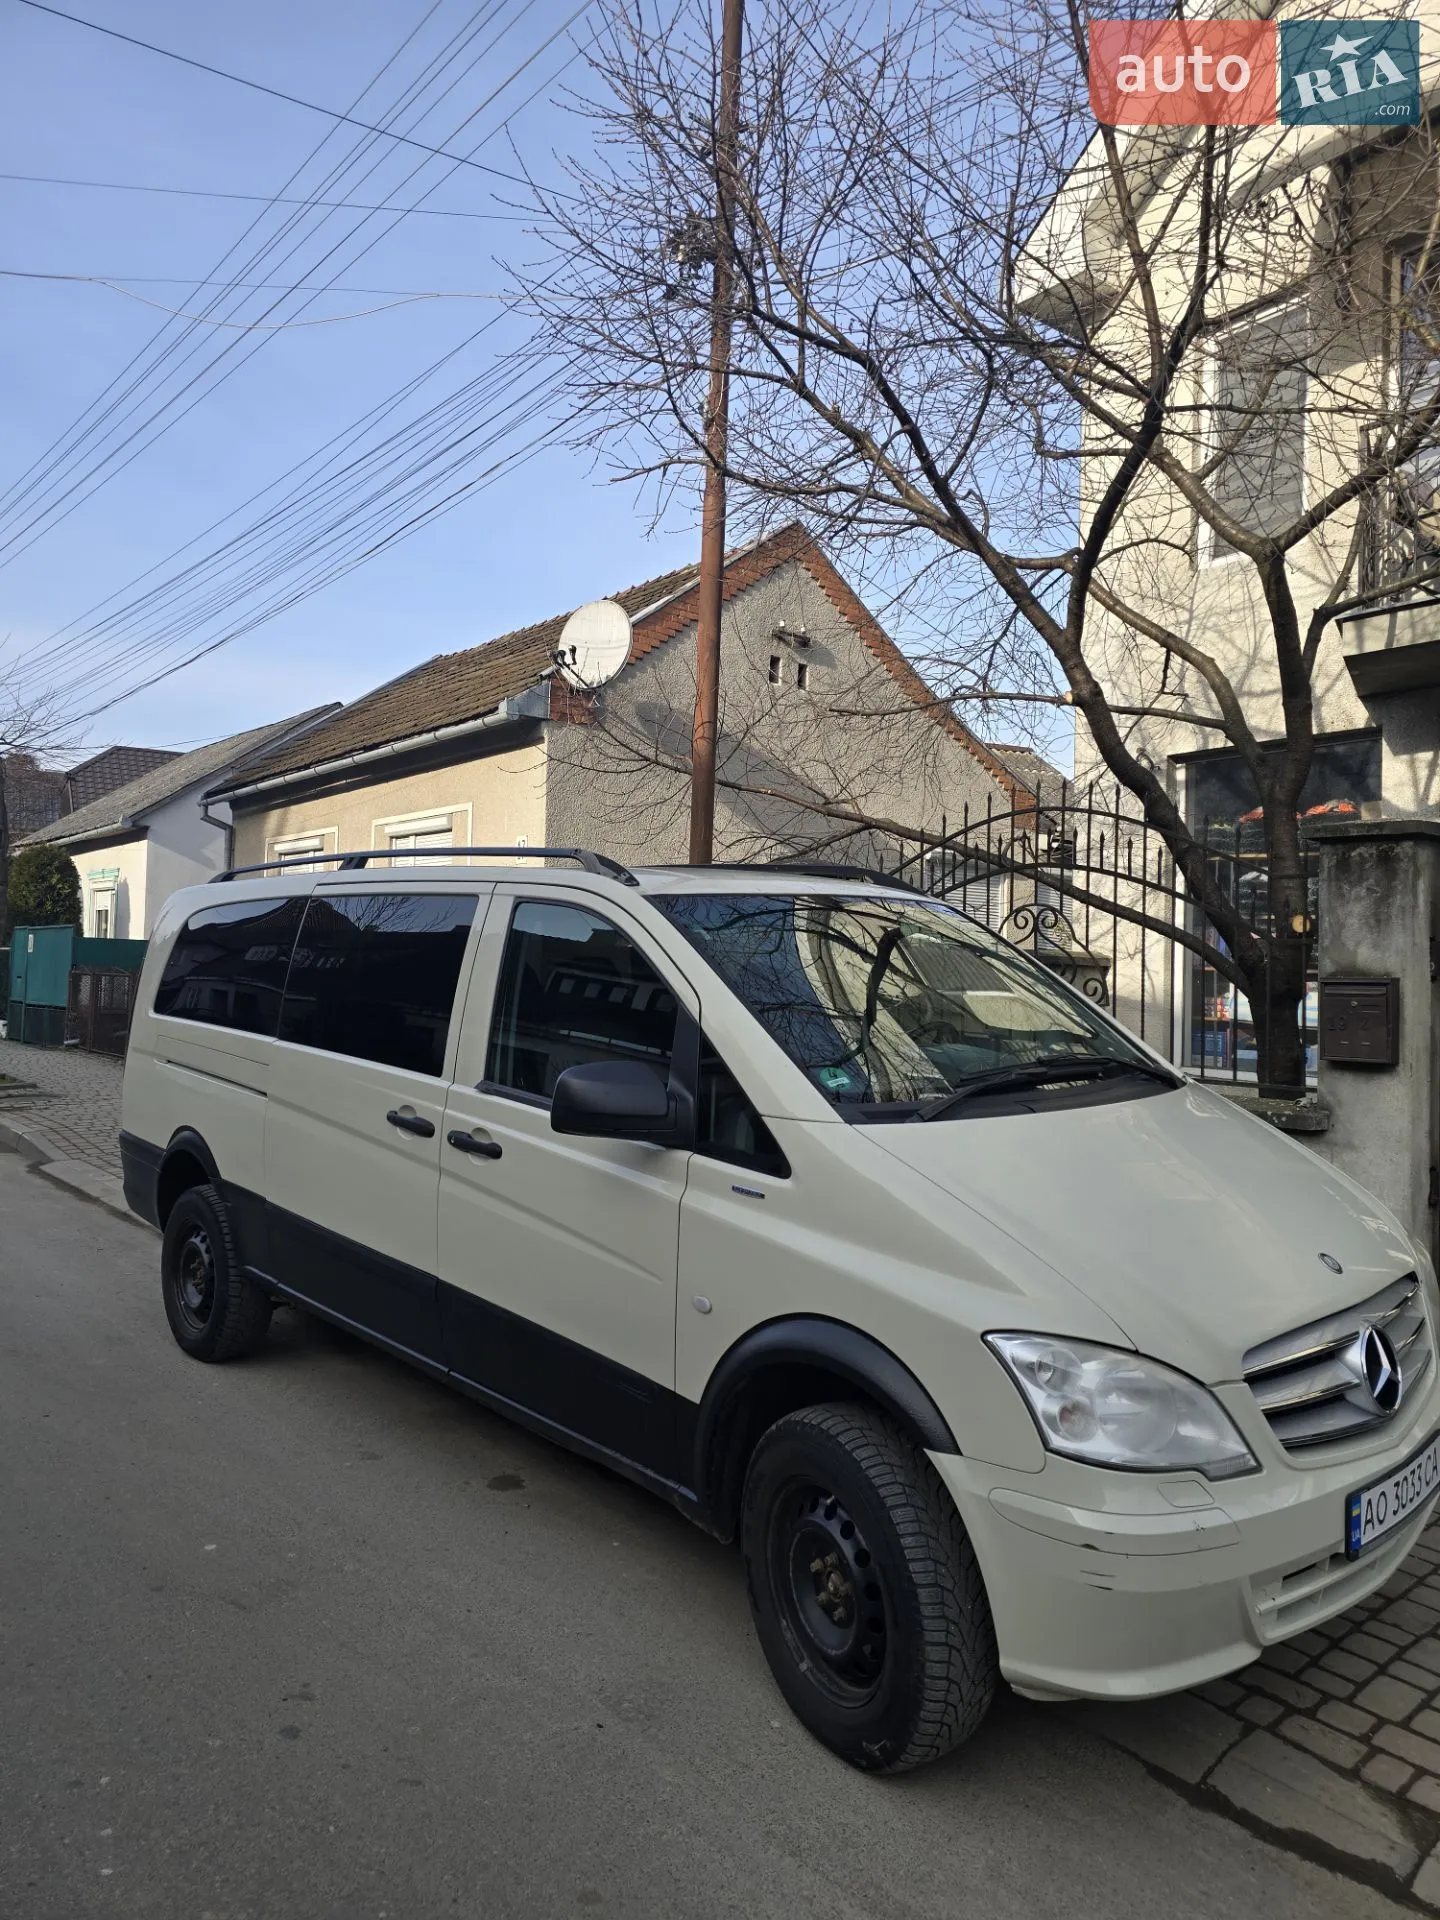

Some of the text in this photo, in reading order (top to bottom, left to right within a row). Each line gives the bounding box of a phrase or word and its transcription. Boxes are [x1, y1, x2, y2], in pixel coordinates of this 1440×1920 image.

[1363, 1447, 1438, 1536] AO 3033 CA
[1352, 1528, 1360, 1542] UA
